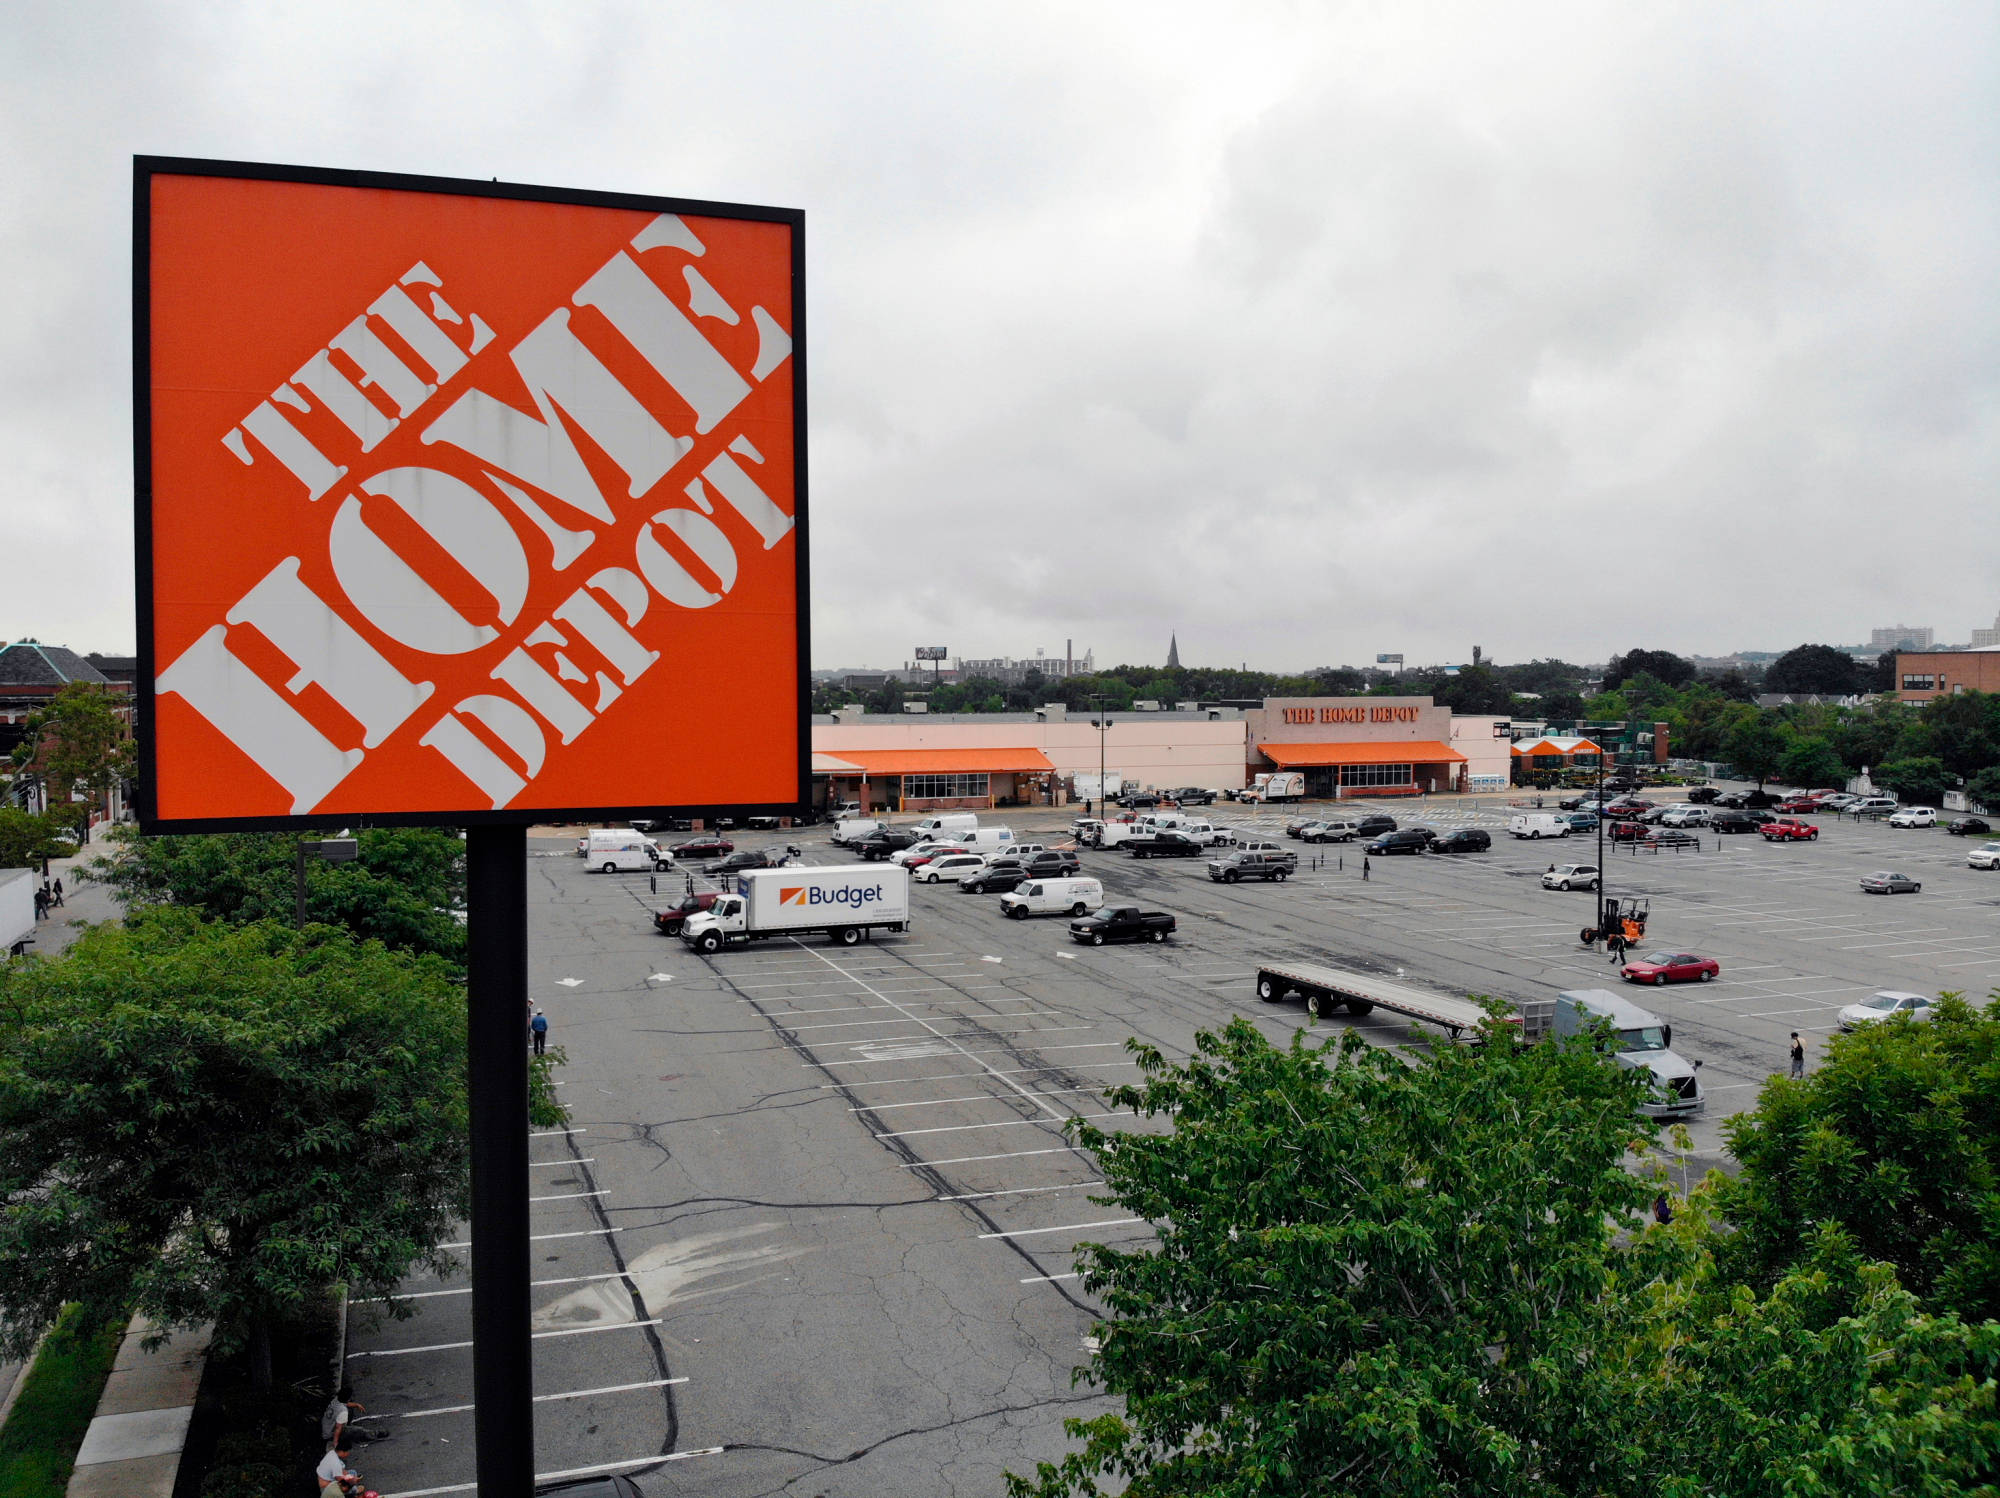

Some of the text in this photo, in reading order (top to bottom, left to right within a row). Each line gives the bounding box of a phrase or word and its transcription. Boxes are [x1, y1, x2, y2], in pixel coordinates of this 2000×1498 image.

[220, 260, 497, 502] THE
[154, 212, 793, 815] HOME
[418, 433, 796, 811] DEPOT
[1282, 705, 1419, 724] THE HOME DEPOT
[809, 884, 883, 909] Budget
